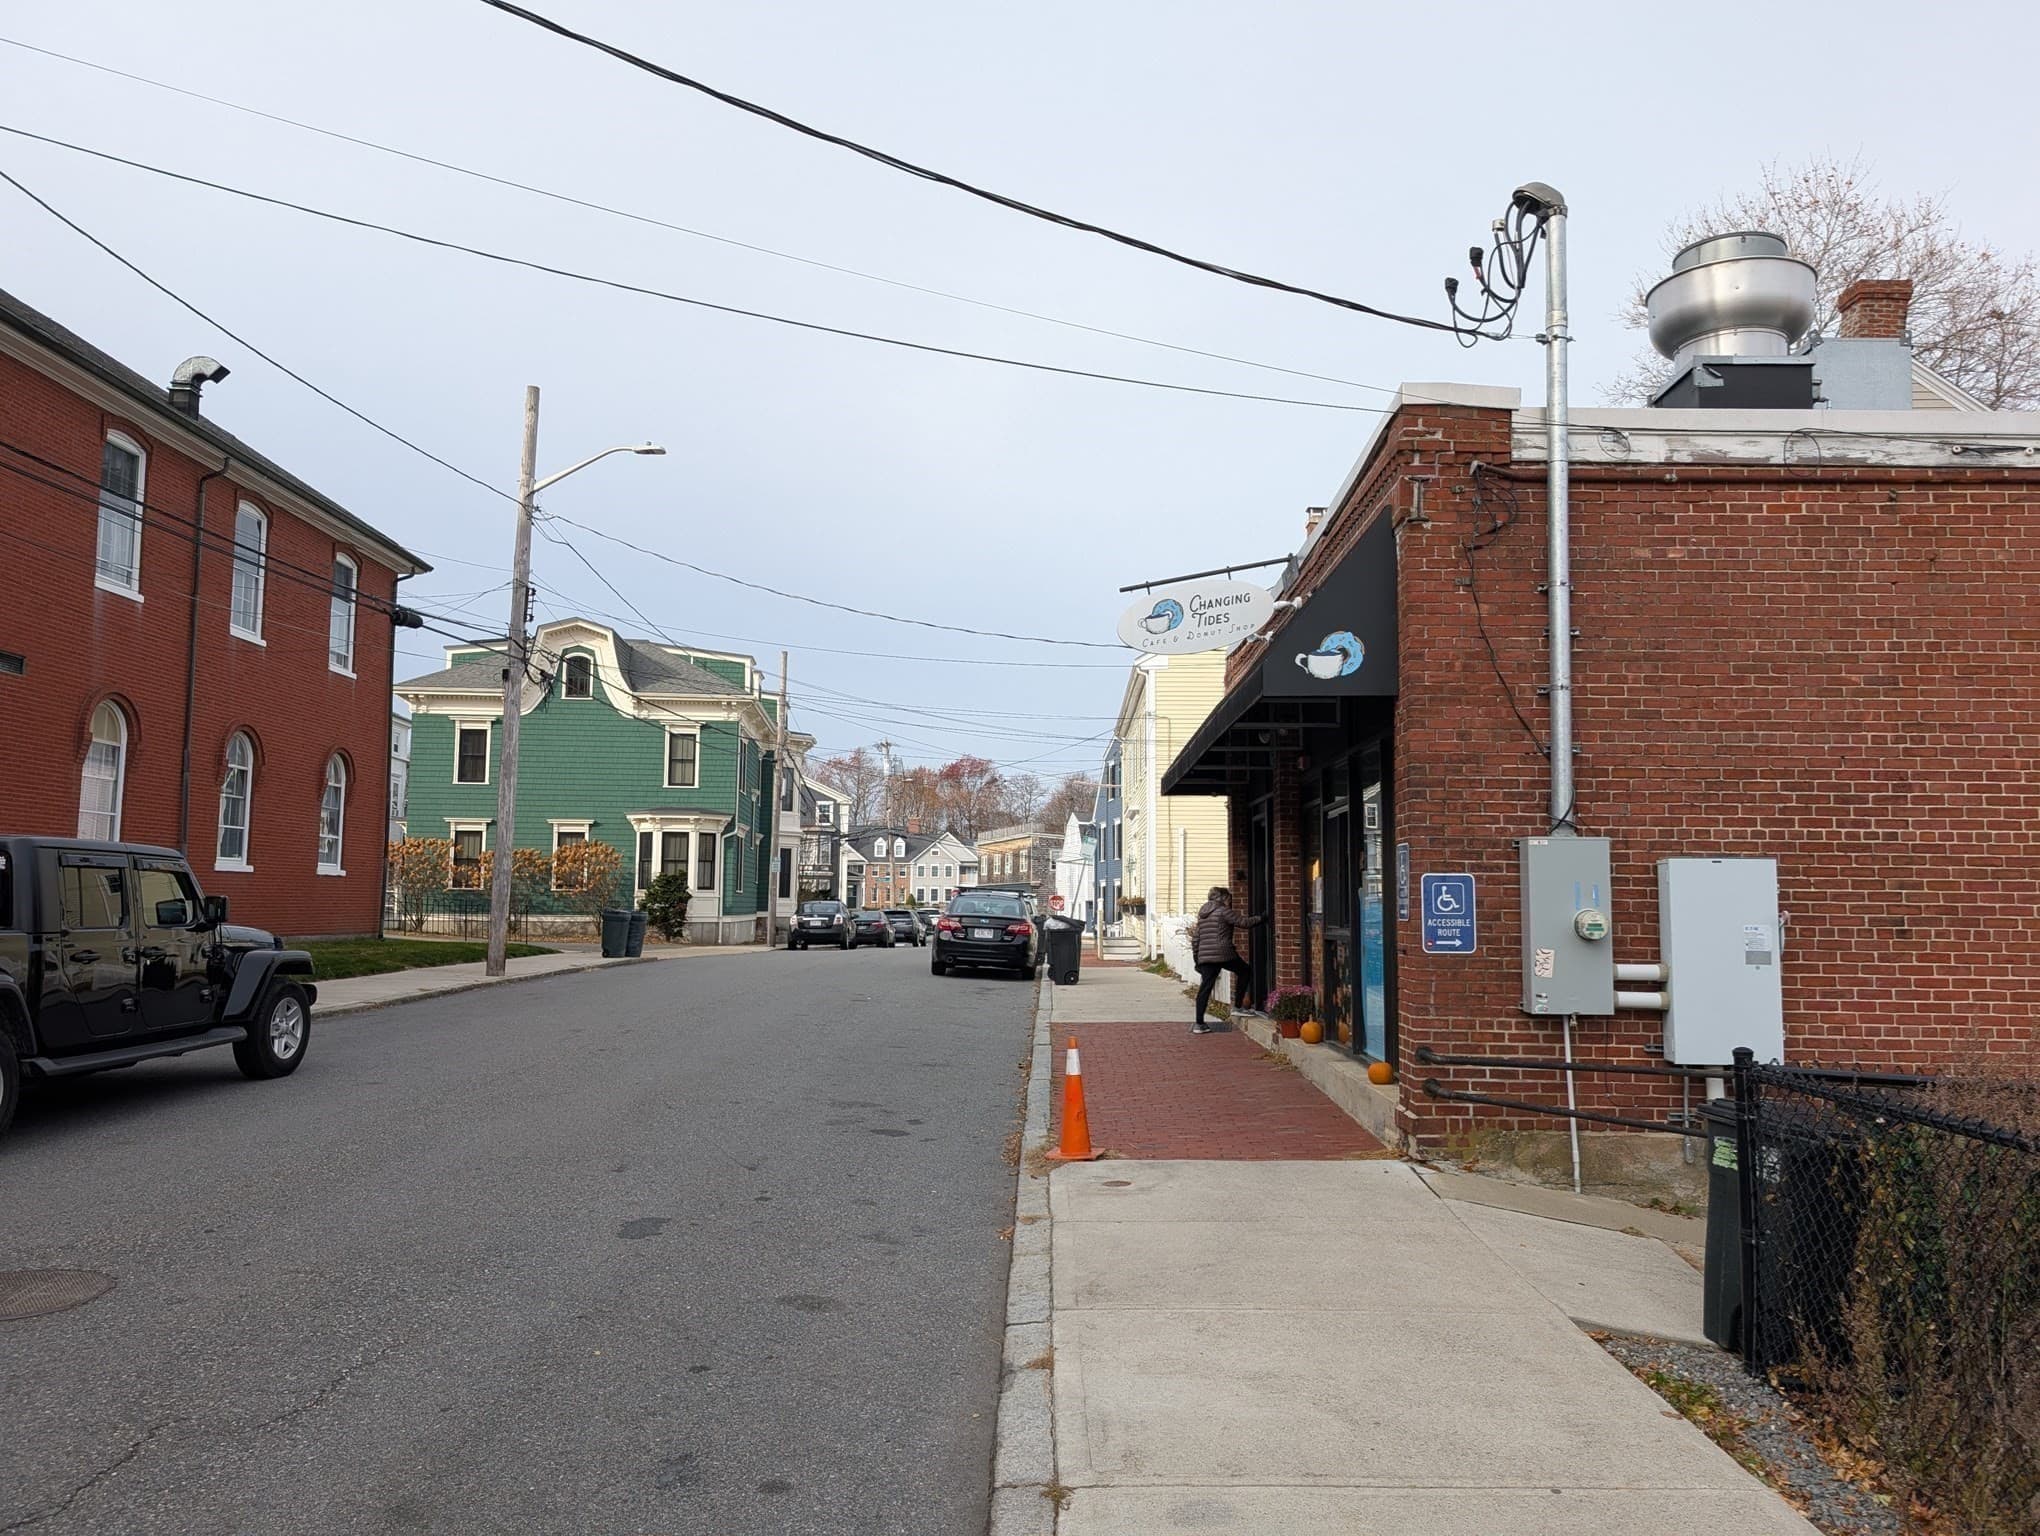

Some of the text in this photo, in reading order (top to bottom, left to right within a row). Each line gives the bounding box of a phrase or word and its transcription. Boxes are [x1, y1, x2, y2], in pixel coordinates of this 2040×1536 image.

[1189, 593, 1251, 613] CHANGING
[1191, 611, 1230, 628] TIDES
[1186, 629, 1223, 641] DONUT
[1228, 623, 1256, 634] SHOP
[1427, 918, 1471, 927] ACCESSIBLE
[1437, 928, 1461, 937] ROUTE
